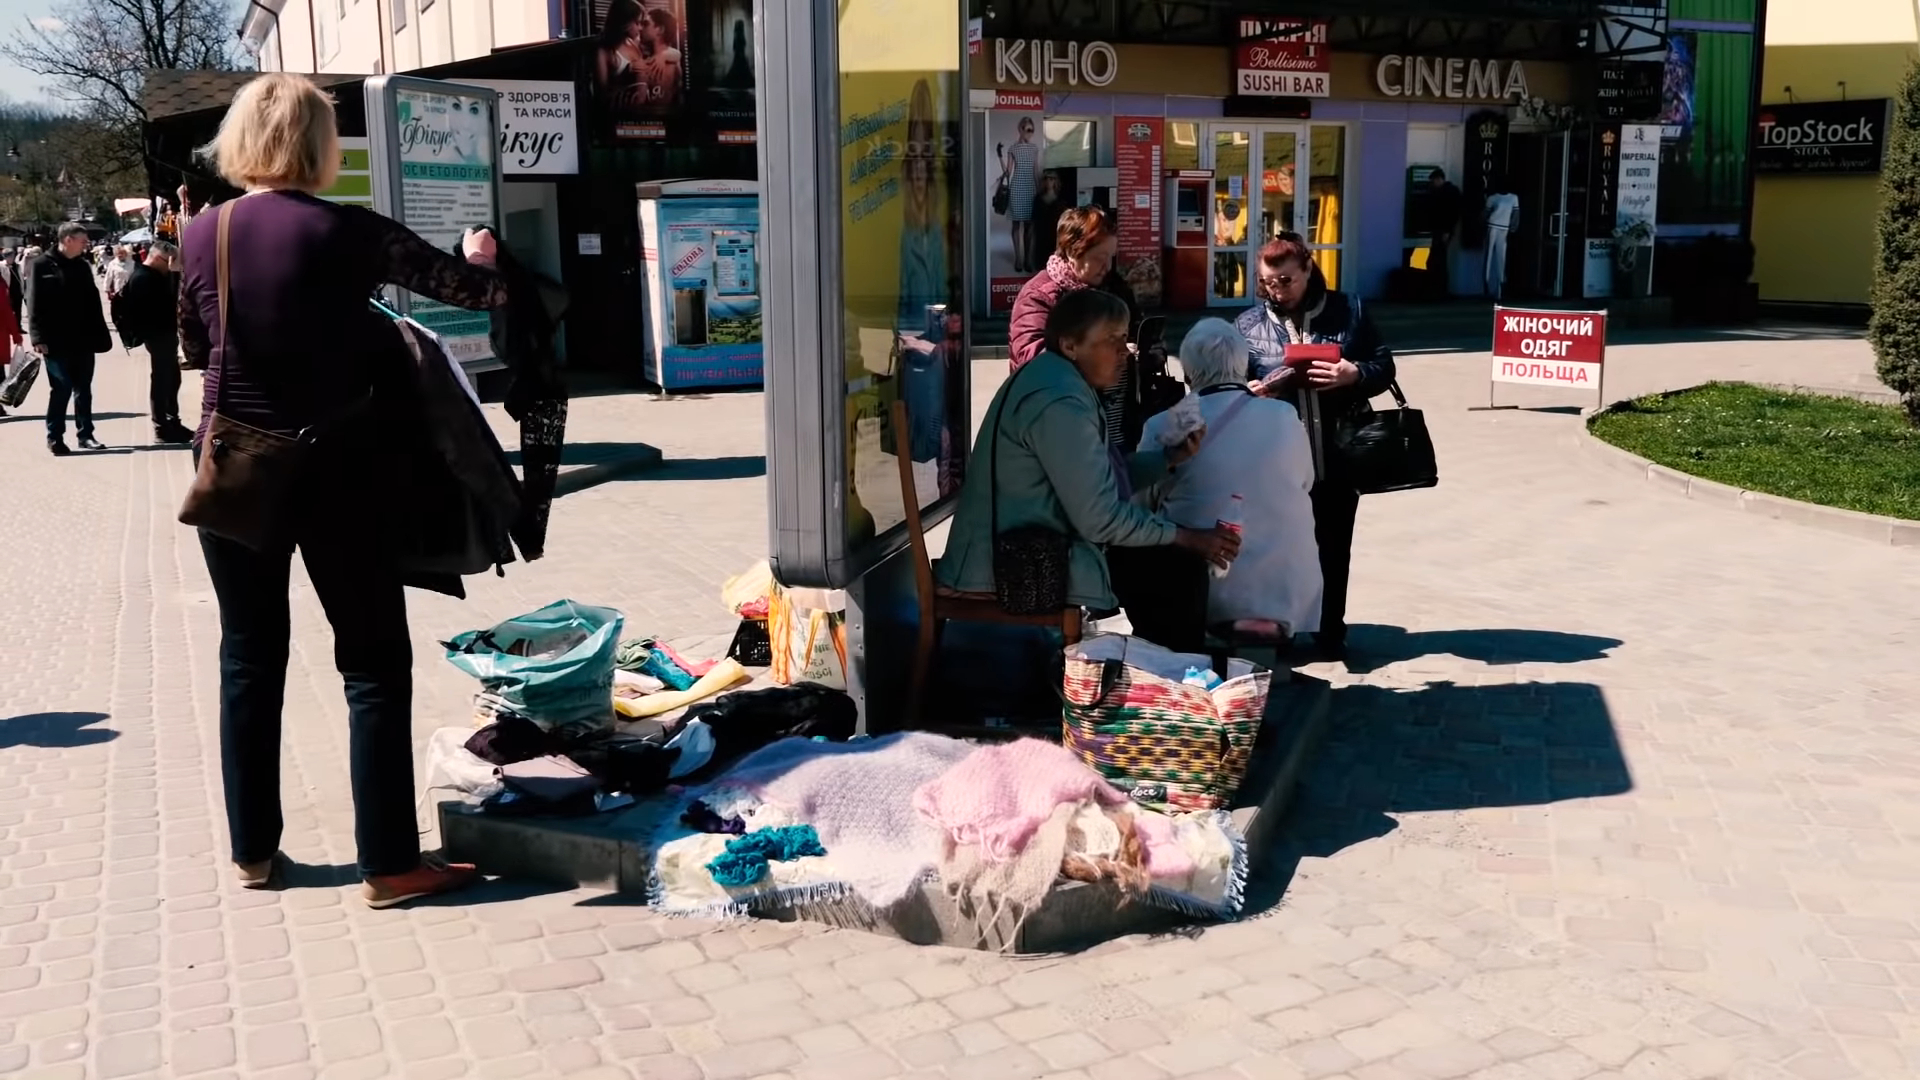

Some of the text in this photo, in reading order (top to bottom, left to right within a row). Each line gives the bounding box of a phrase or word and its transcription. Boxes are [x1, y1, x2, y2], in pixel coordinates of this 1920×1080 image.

[995, 37, 1117, 86] КІНО
[1249, 47, 1317, 69] Bellisimo
[1243, 74, 1324, 94] SUSHI BAR
[1376, 54, 1528, 99] CINEMA
[508, 92, 571, 104] ЗДОРОВ'Я
[513, 108, 571, 119] ТА КРАСИ
[1758, 116, 1874, 150] TopStock
[500, 123, 564, 168] ікус
[1794, 146, 1831, 156] STOCK
[1621, 152, 1656, 161] IMPERIAL
[403, 165, 489, 179] ОСМЕТОЛОГИЯ
[1601, 145, 1612, 215] ROYAL
[671, 246, 703, 276] СОДОВА
[1503, 316, 1593, 336] ЖІНОЧИЙ
[1520, 338, 1573, 358] ОДЯГ
[1502, 362, 1588, 384] ПОЛЬЩА
